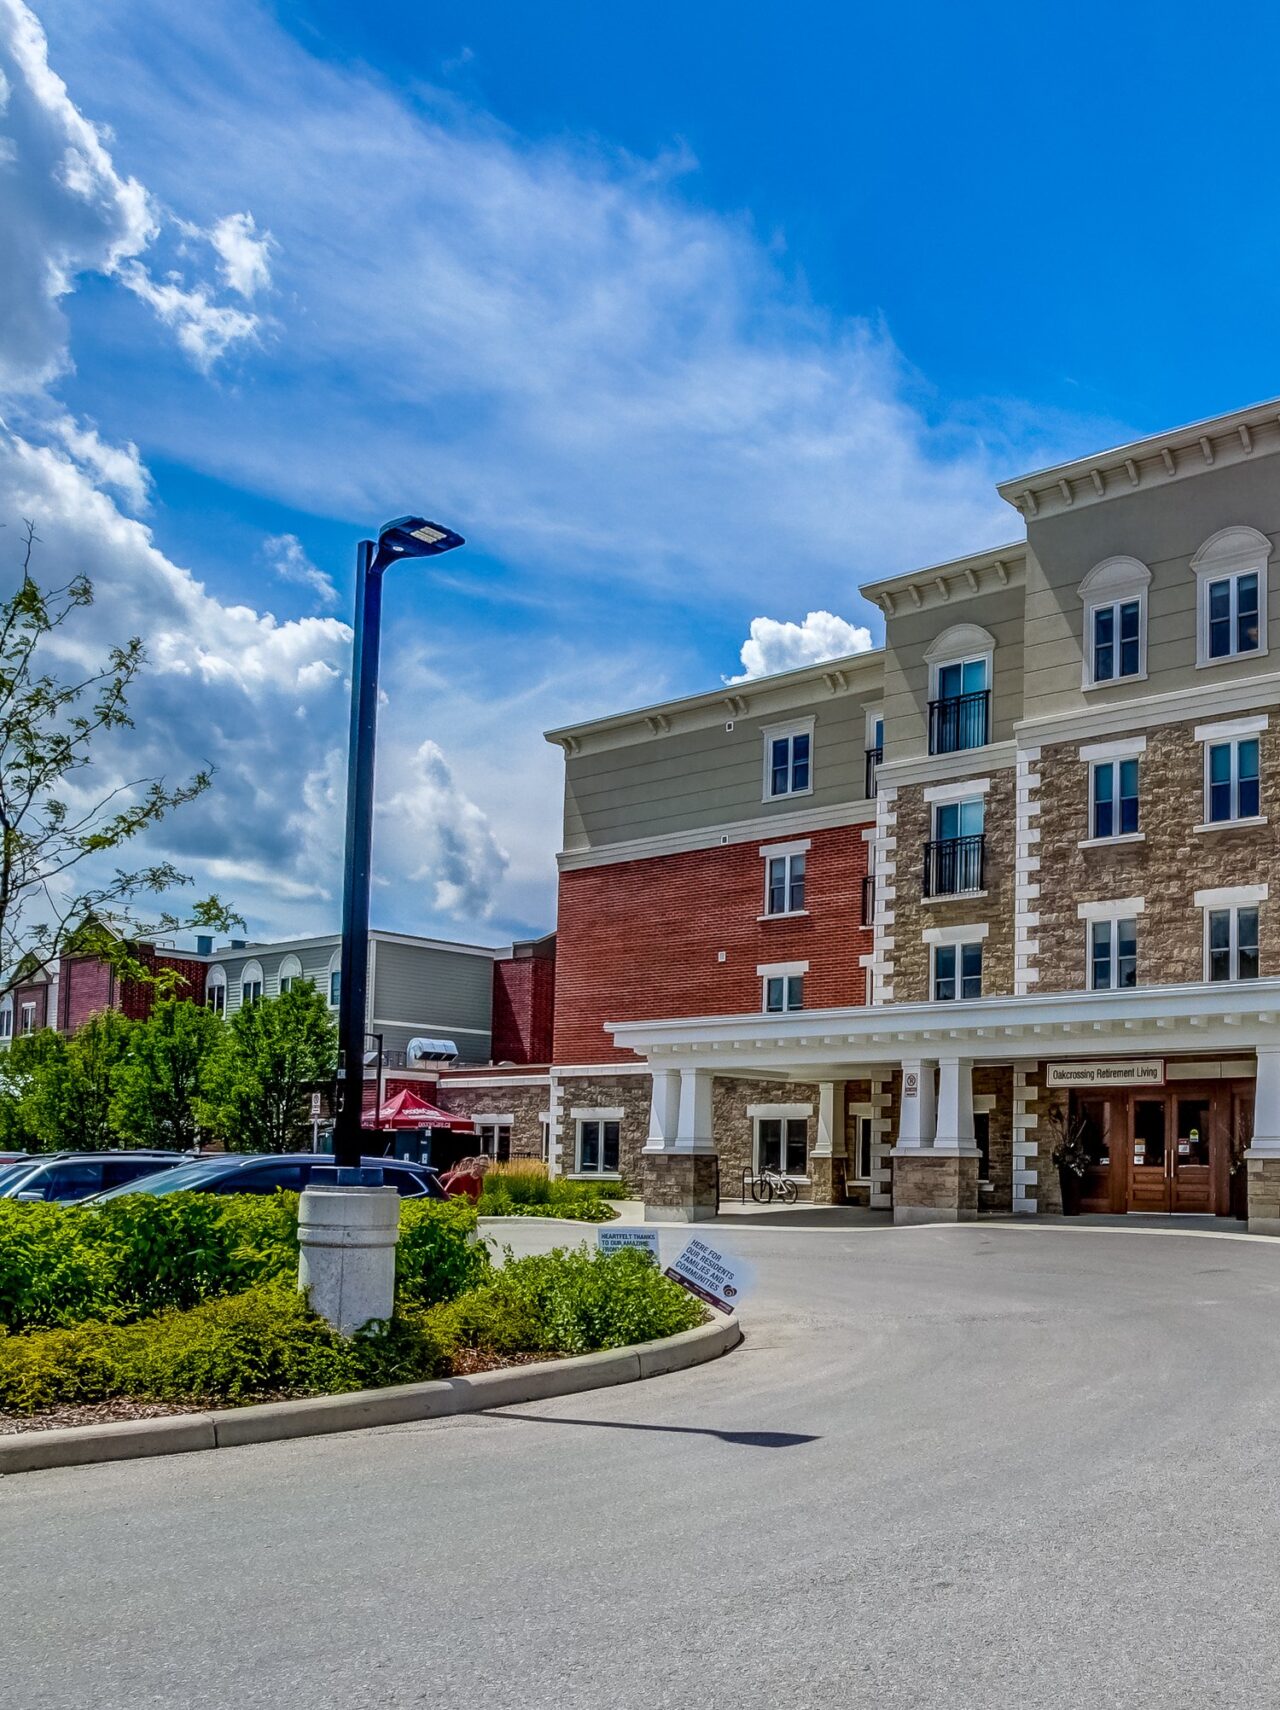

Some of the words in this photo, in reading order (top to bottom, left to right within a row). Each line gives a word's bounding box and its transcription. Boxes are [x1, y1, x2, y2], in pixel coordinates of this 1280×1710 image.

[1053, 1069, 1095, 1081] Oakcrossing
[1096, 1068, 1135, 1079] Retirement
[1136, 1066, 1158, 1079] Living
[686, 1246, 701, 1259] OUR
[699, 1254, 735, 1280] RESIDENTS
[691, 1239, 709, 1254] HERE
[708, 1249, 722, 1262] FOR
[675, 1260, 720, 1291] COMMUNITIES
[680, 1252, 711, 1276] FAMILIES
[709, 1272, 725, 1284] AND
